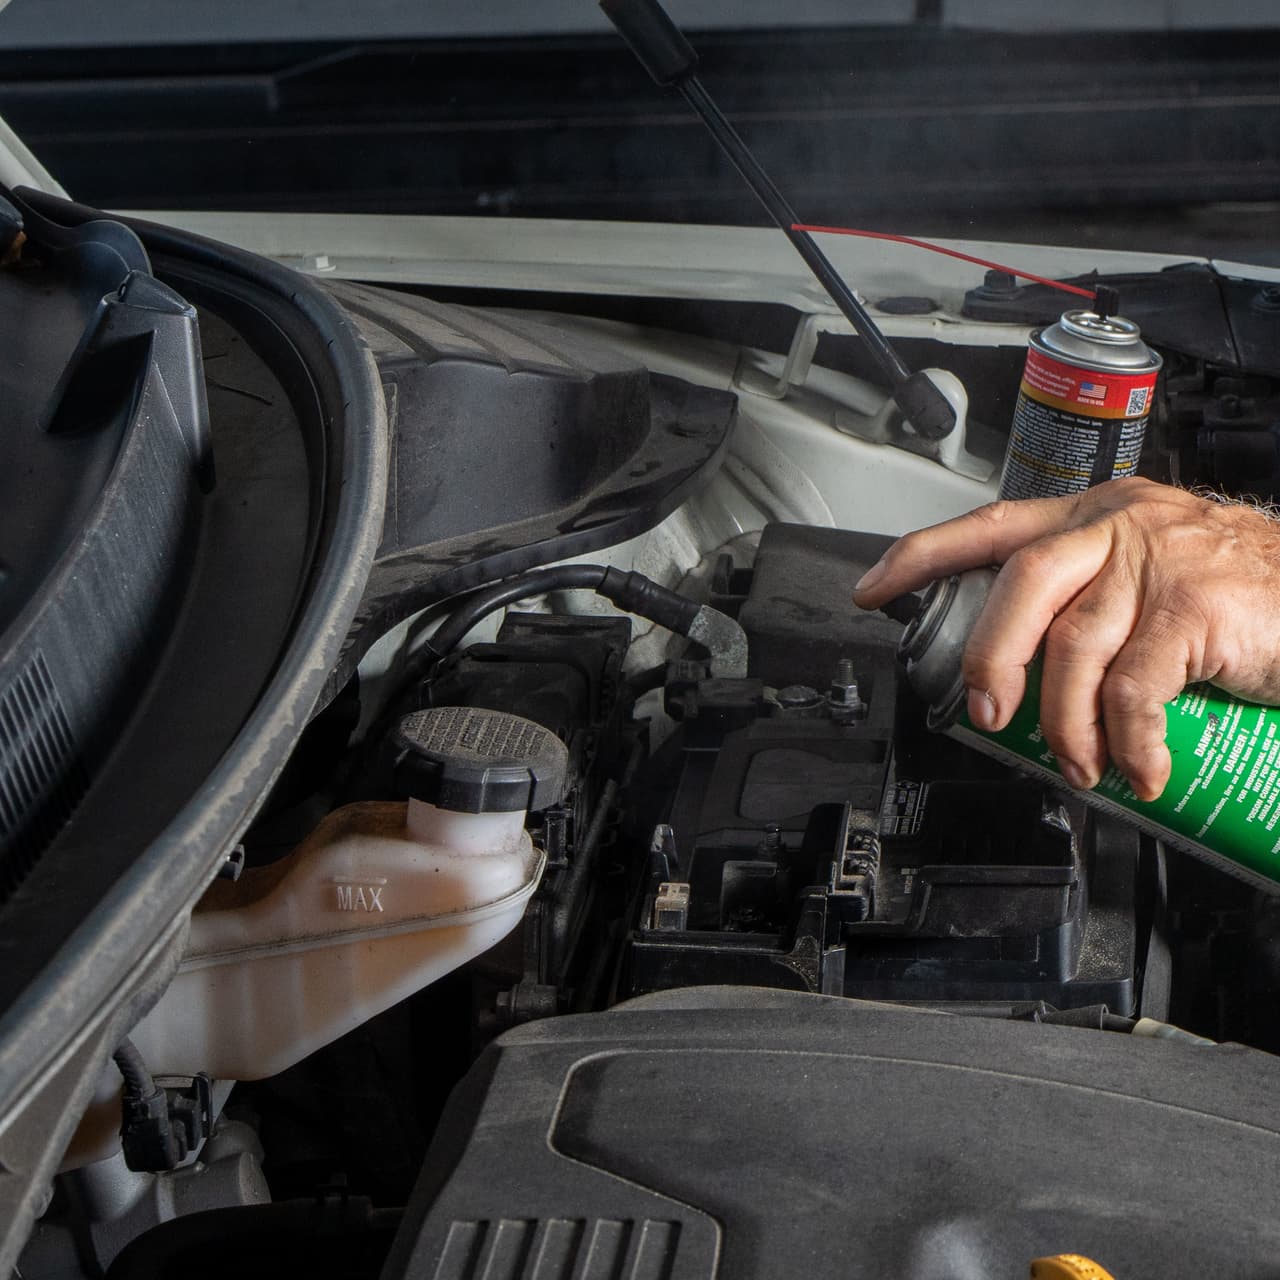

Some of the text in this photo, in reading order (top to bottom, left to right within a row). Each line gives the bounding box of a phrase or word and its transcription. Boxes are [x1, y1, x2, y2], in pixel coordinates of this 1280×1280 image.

[1224, 734, 1247, 772] DANGER
[1236, 789, 1247, 803] FOR
[337, 886, 384, 912] MAX
